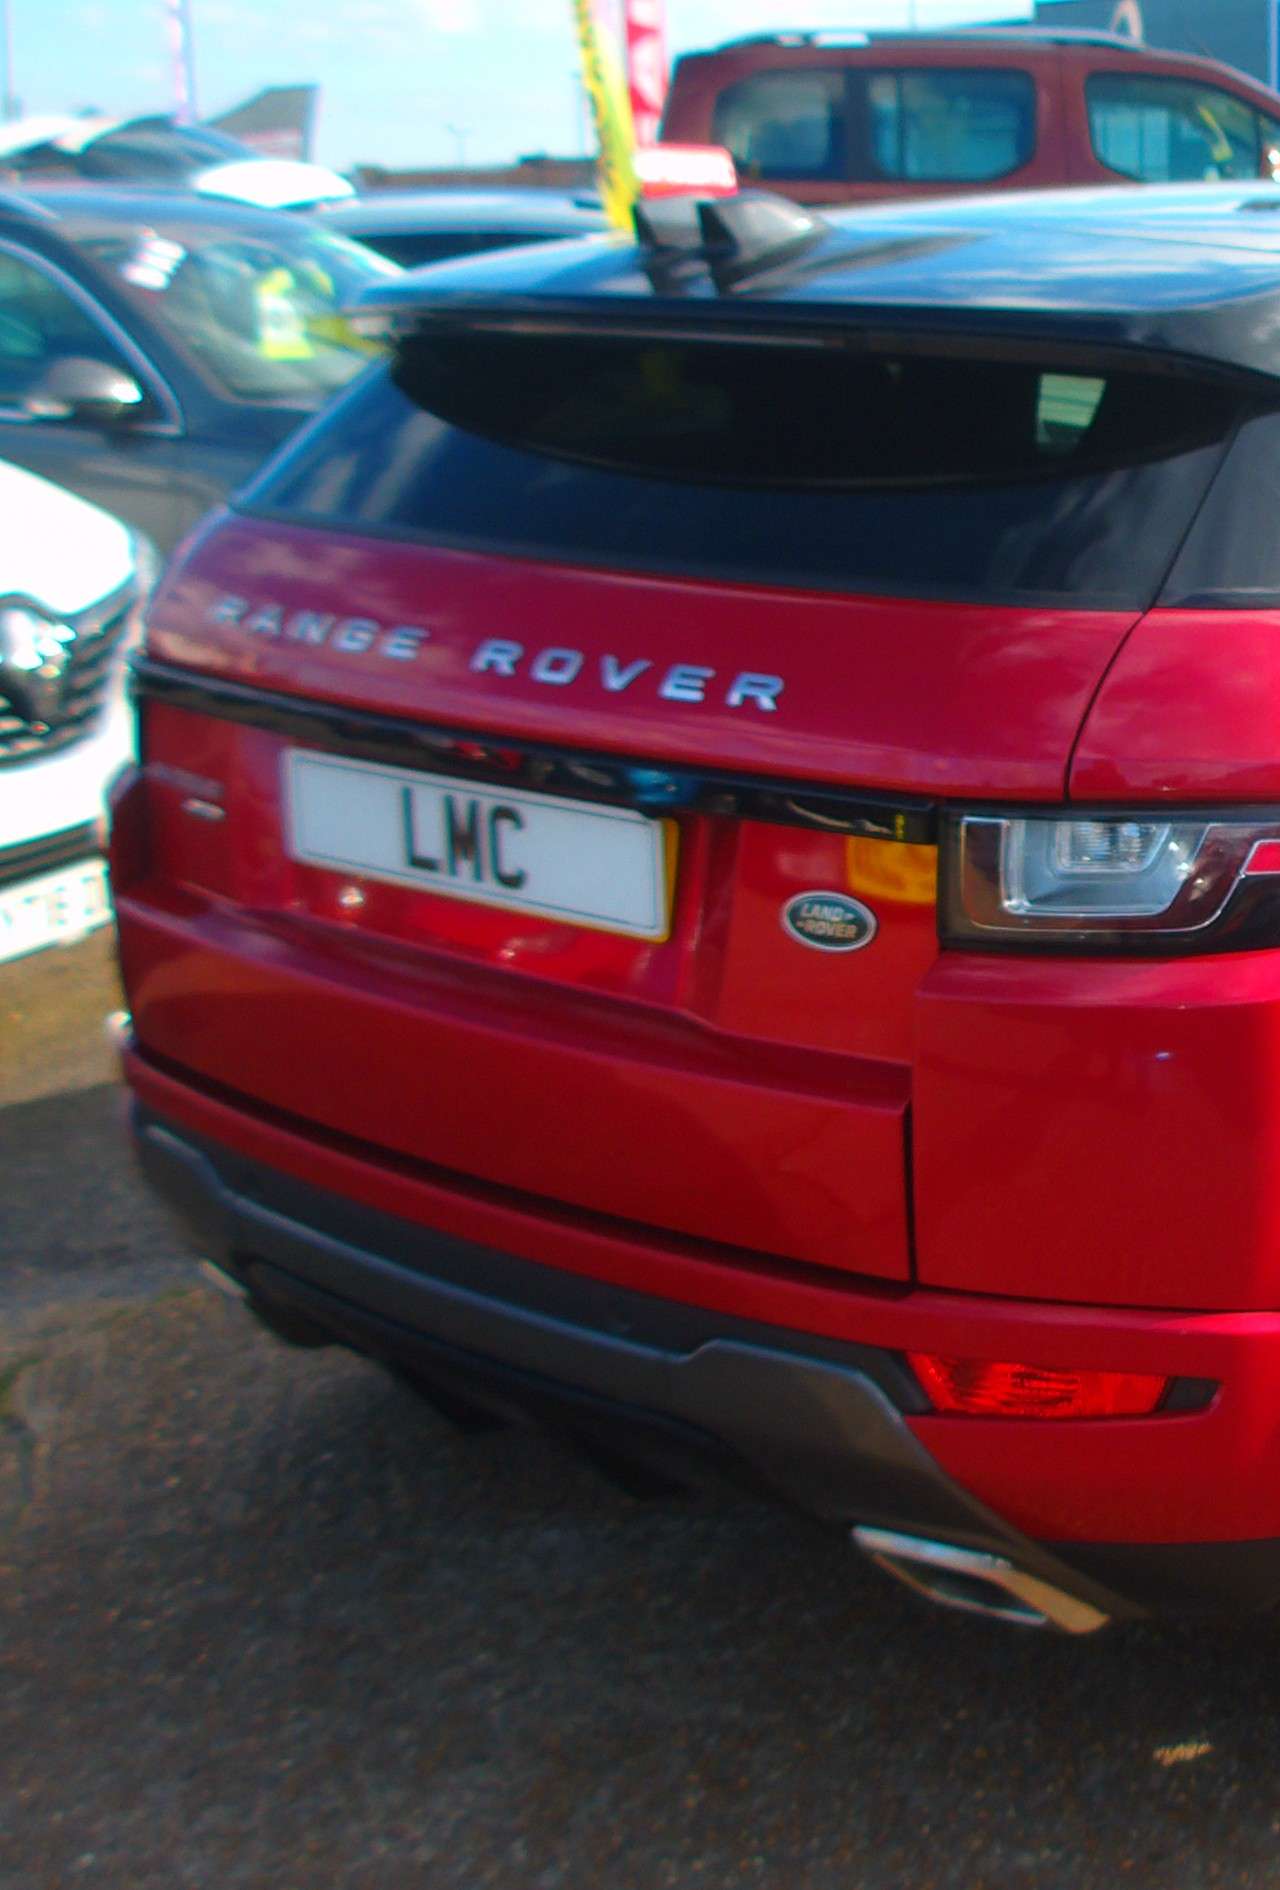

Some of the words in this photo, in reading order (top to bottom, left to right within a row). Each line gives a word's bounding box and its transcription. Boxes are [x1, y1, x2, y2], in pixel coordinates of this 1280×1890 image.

[207, 597, 430, 662] RANGE
[470, 638, 785, 713] ROVER
[401, 785, 528, 891] LMC
